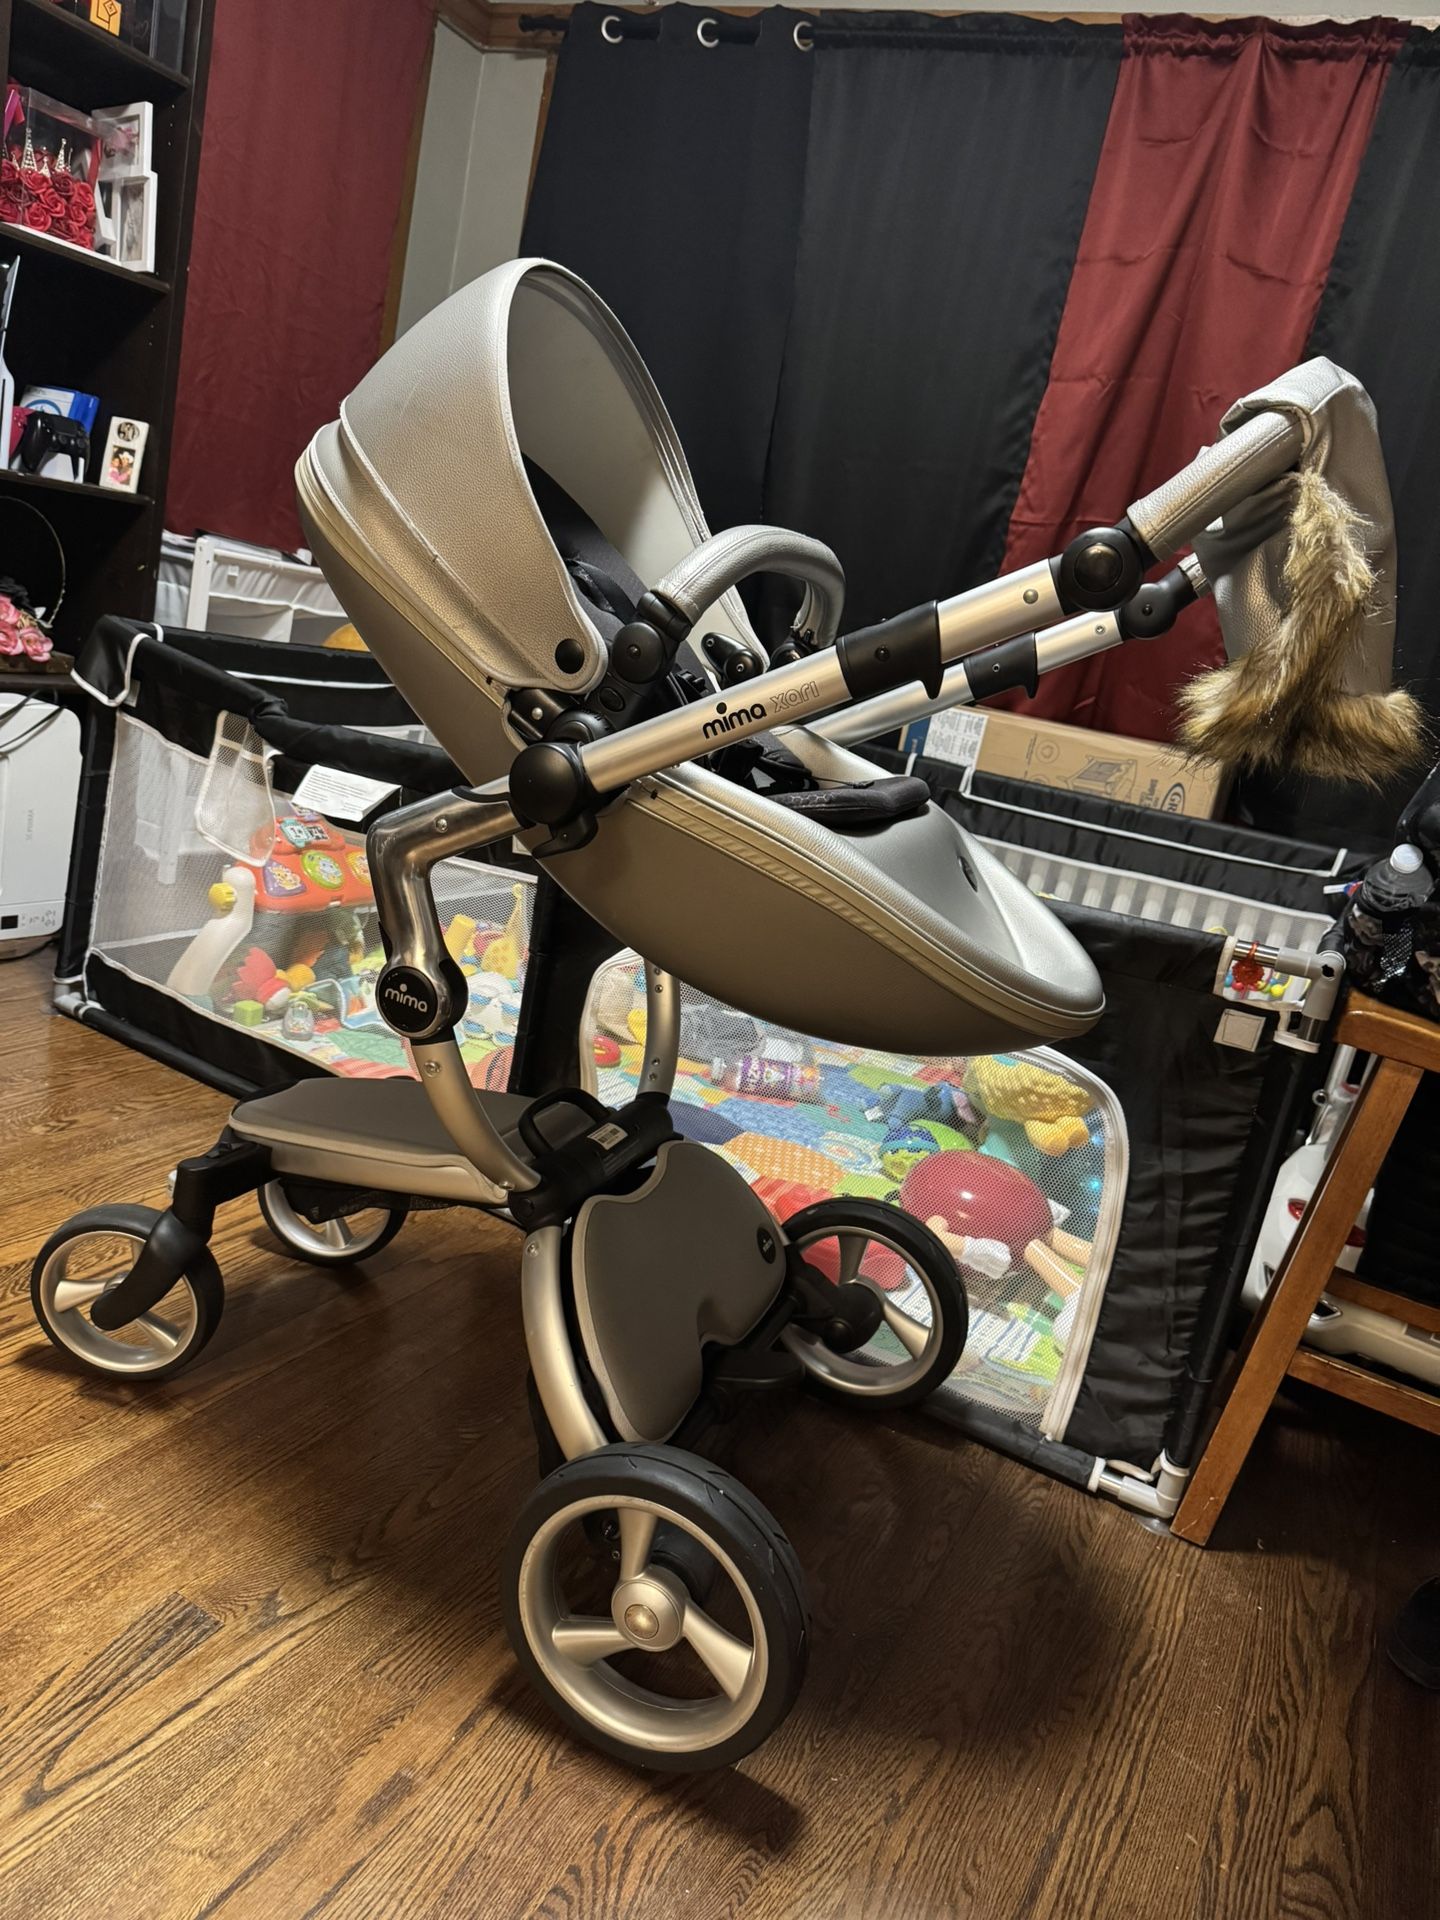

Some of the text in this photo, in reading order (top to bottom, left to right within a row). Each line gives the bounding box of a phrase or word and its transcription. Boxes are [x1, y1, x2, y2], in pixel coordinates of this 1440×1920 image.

[703, 681, 819, 739] mima xari
[385, 983, 428, 1013] mima
